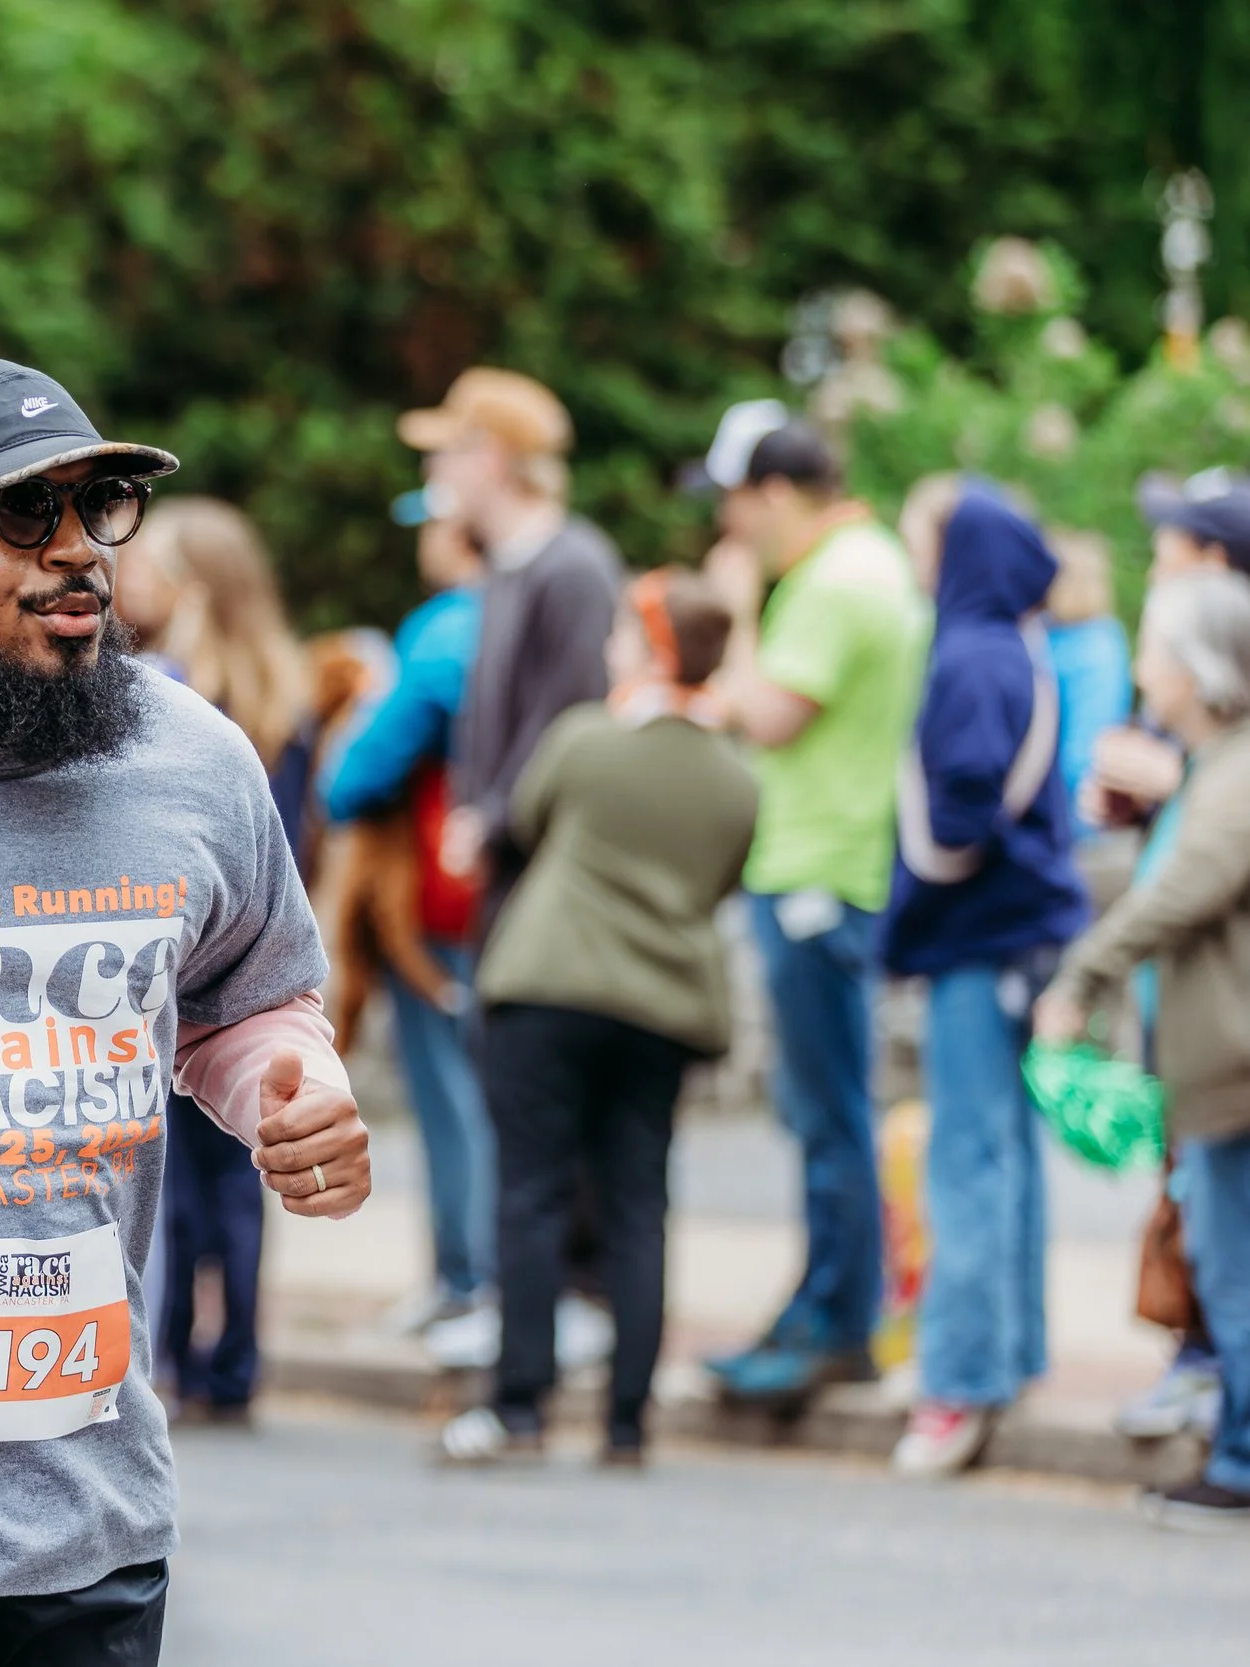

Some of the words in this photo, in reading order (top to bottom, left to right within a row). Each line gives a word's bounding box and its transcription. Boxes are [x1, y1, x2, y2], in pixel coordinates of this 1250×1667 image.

[23, 396, 48, 409] NIKE
[13, 875, 187, 918] Running!
[0, 1128, 68, 1166] 25,
[10, 1254, 70, 1277] race
[12, 1273, 69, 1287] against
[9, 1284, 70, 1297] RACISM
